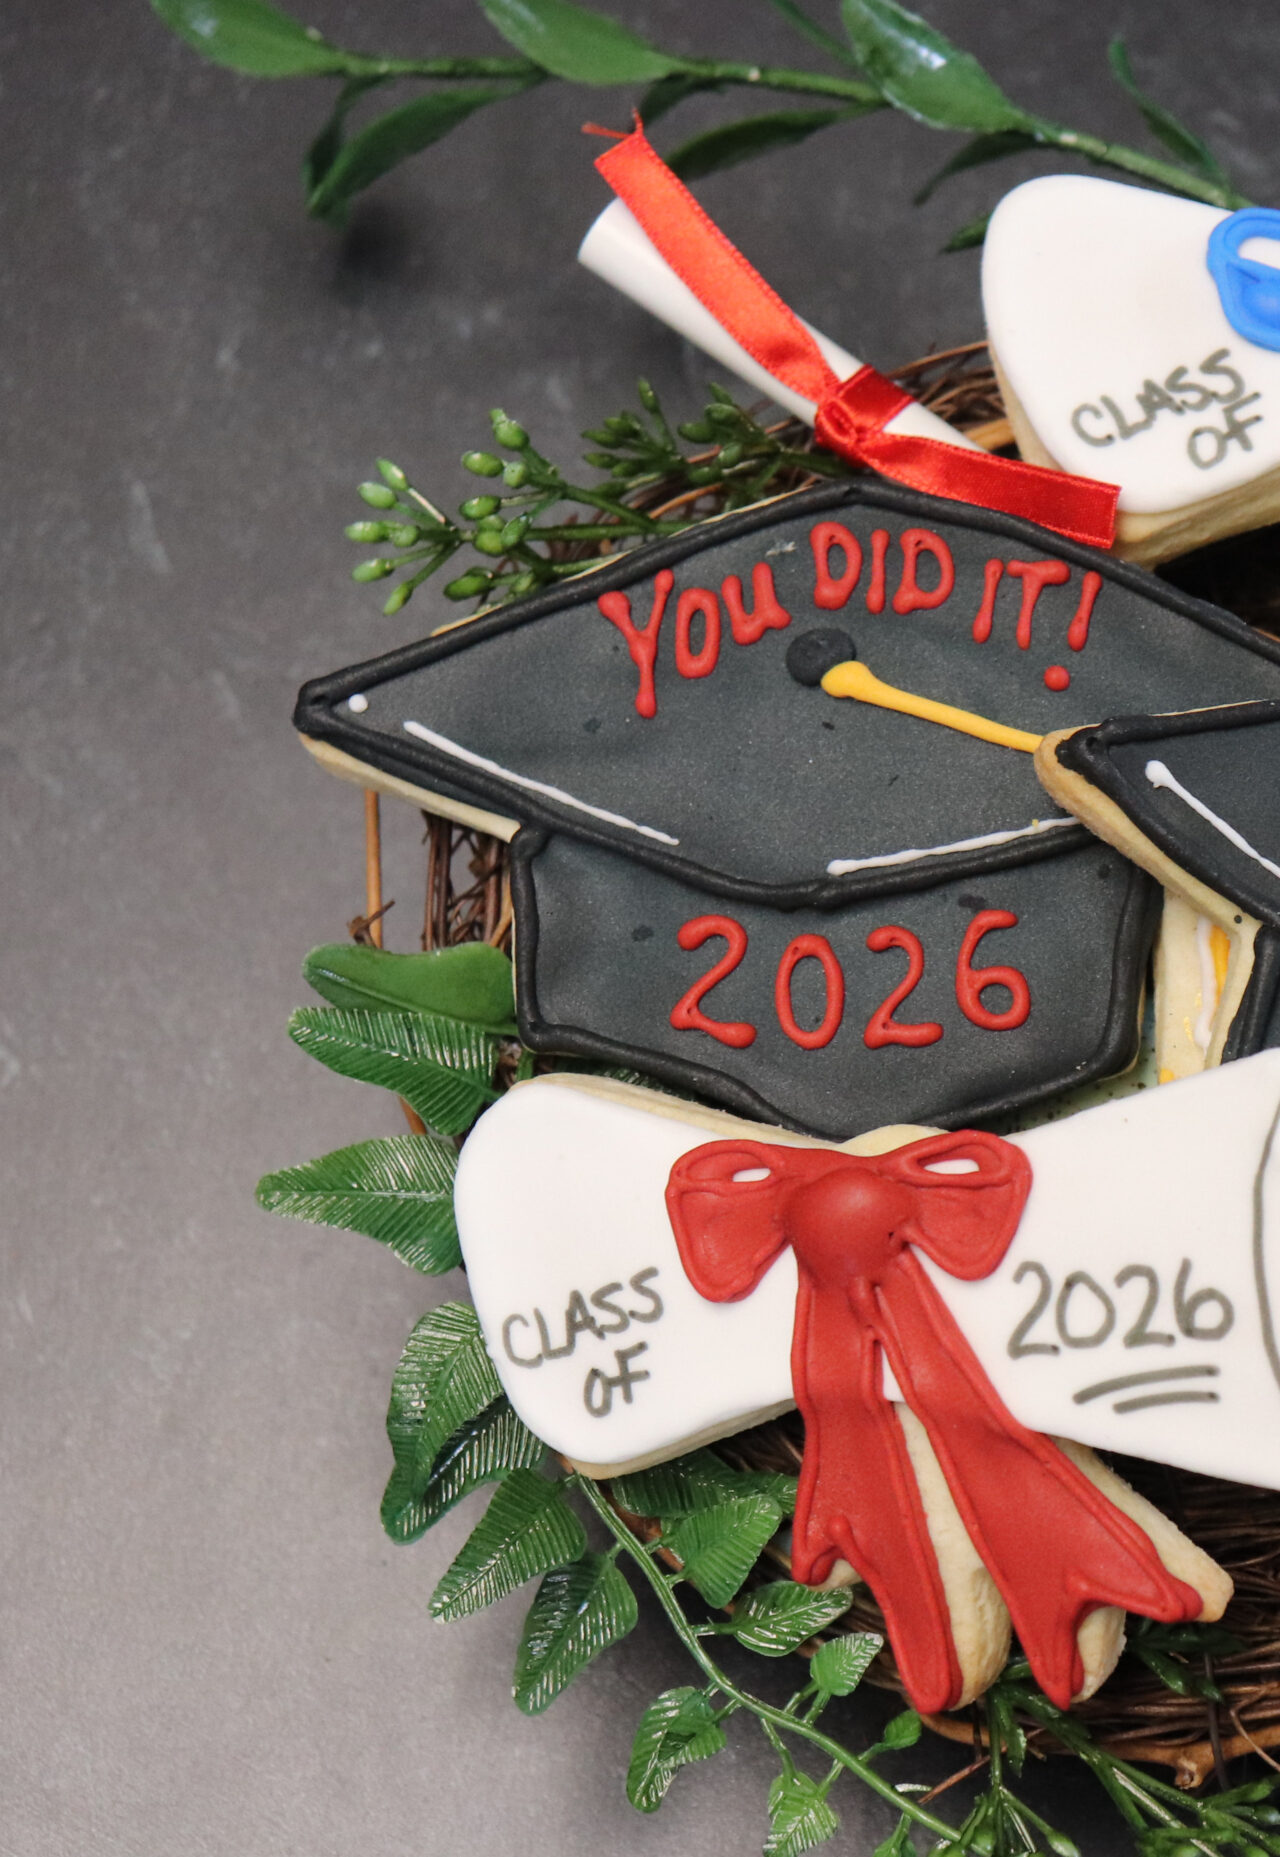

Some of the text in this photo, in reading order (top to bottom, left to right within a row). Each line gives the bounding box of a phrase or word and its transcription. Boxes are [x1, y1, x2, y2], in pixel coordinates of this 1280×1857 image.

[1070, 347, 1246, 448] CLASS
[1186, 390, 1264, 471] OF
[809, 520, 955, 615] DID
[971, 557, 1102, 692] IT!
[669, 909, 1032, 1050] 2026
[501, 1266, 665, 1369] CLASS
[1007, 1256, 1236, 1360] 2026
[583, 1340, 652, 1419] OF
